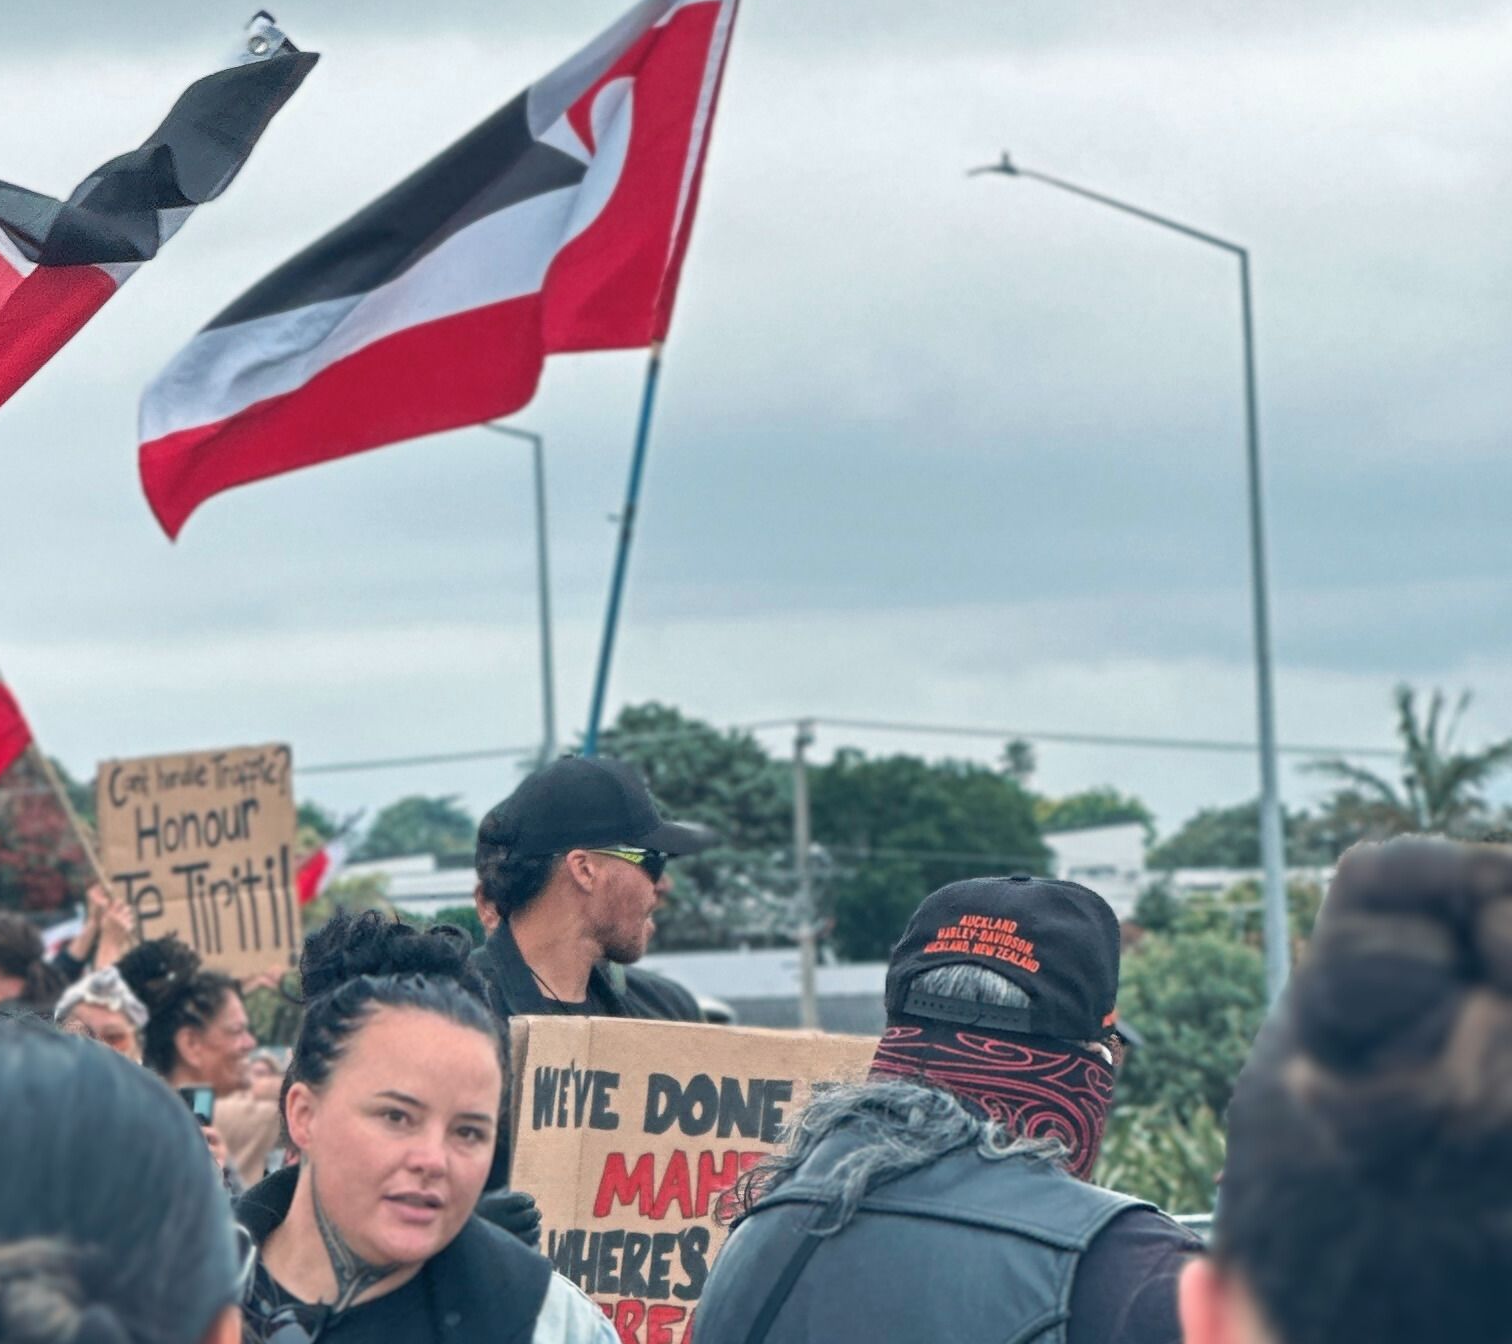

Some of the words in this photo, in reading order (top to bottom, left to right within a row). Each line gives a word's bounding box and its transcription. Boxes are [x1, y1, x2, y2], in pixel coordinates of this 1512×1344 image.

[135, 796, 259, 860] Honour
[171, 844, 297, 967] Tiriti!
[959, 915, 1018, 934] AUCKLAND
[972, 942, 996, 957] NEW
[995, 946, 1041, 973] ZEALAND
[532, 1059, 620, 1130] WE'VE
[643, 1072, 793, 1144] DONE
[548, 1226, 710, 1301] WHERE'S
